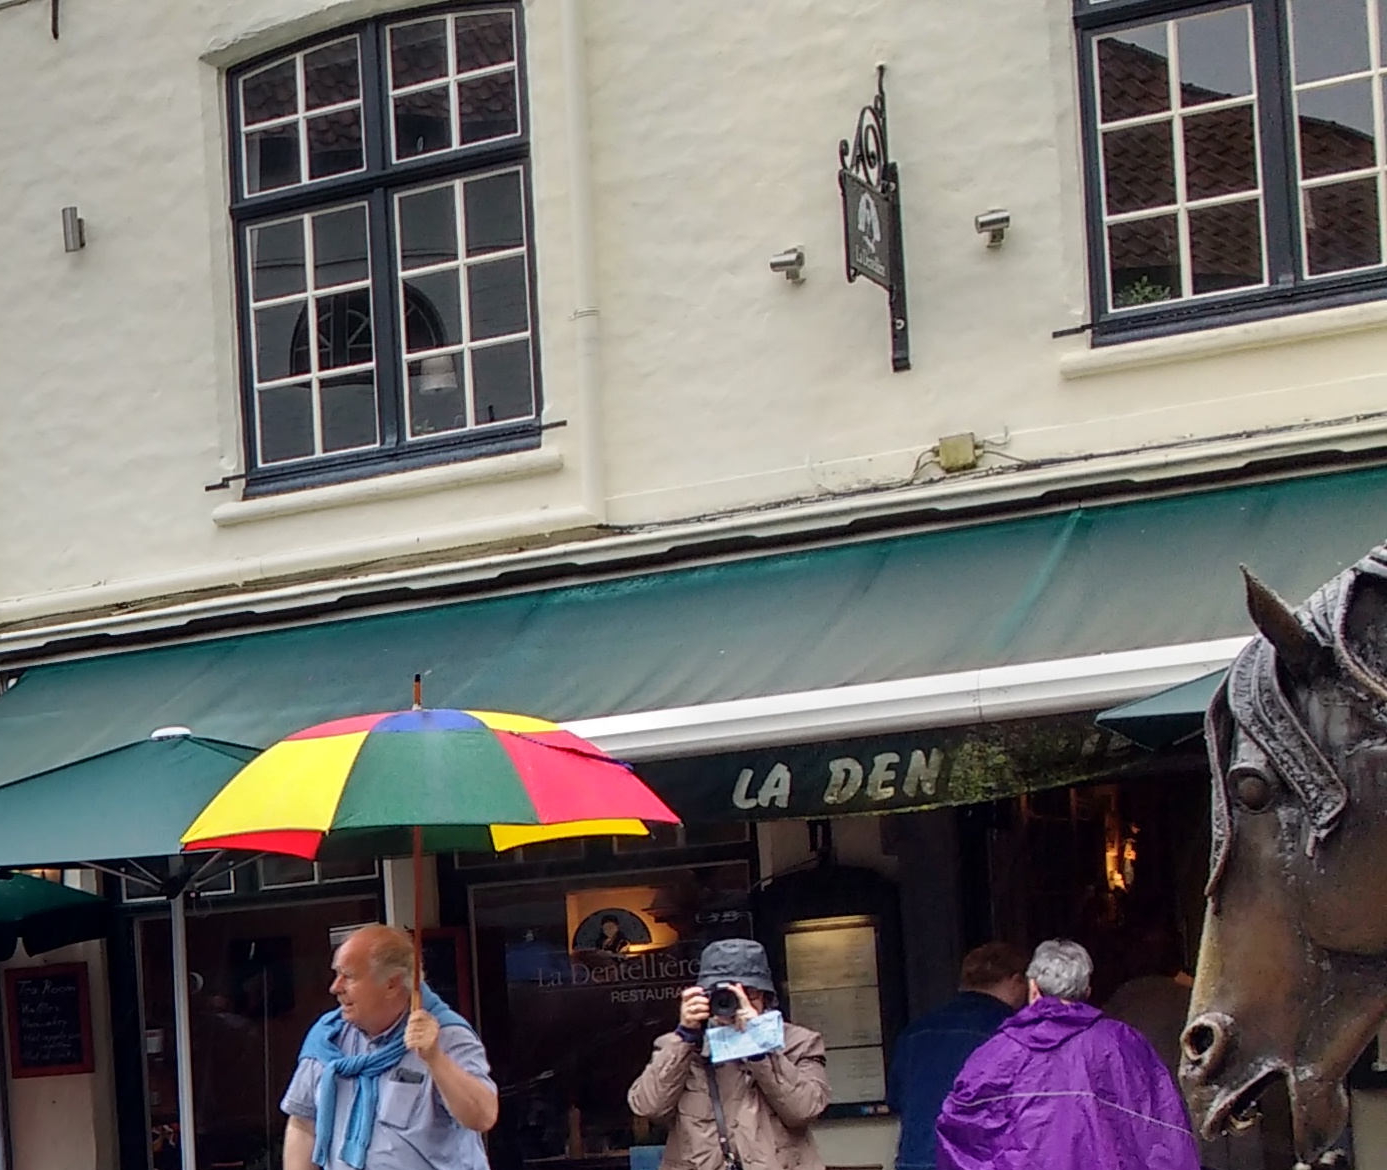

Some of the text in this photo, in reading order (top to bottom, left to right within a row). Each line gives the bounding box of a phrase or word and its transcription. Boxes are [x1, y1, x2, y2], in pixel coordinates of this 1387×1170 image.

[732, 763, 792, 810] LA
[537, 953, 701, 989] La Dentellière
[611, 986, 683, 1004] RESTAURA
